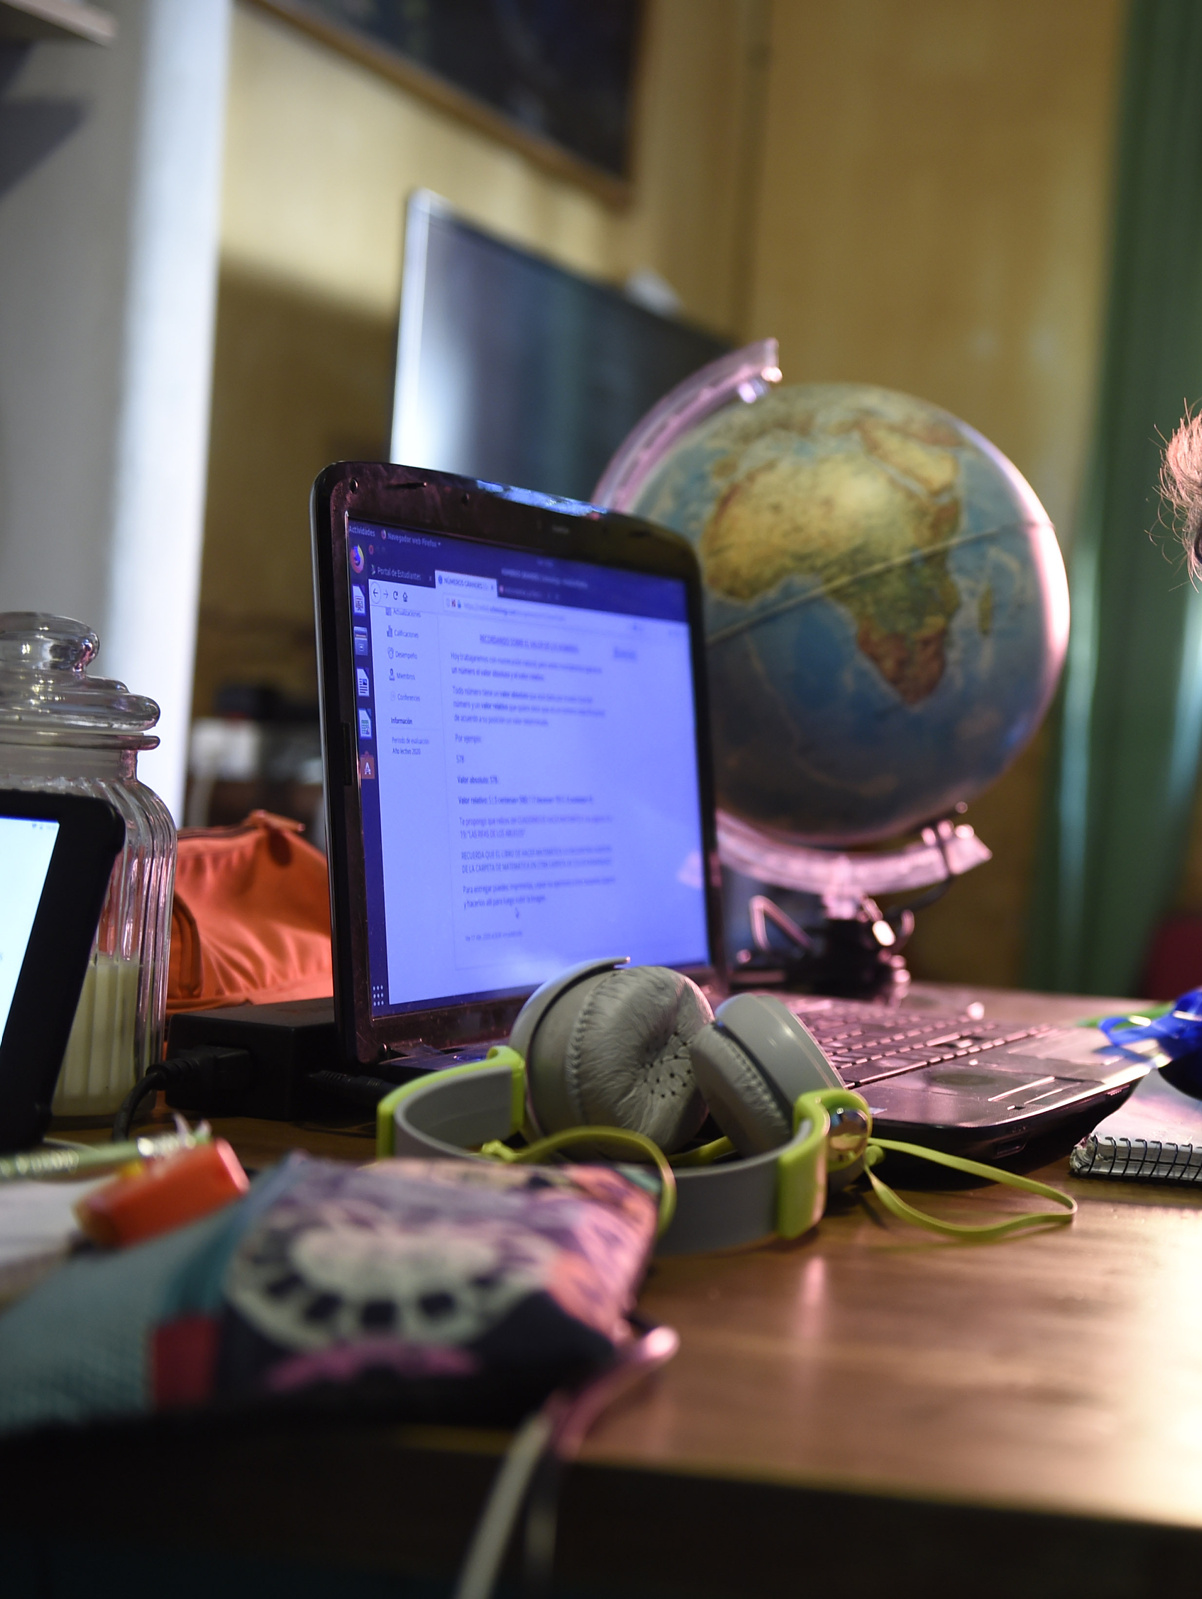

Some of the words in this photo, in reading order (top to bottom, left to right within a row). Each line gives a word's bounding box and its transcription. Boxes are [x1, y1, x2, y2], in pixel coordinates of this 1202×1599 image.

[348, 525, 376, 538] Actividades
[387, 532, 412, 544] Navegador
[421, 536, 437, 548] Firefox
[377, 566, 391, 576] Portal
[397, 569, 422, 581] Estudiantes
